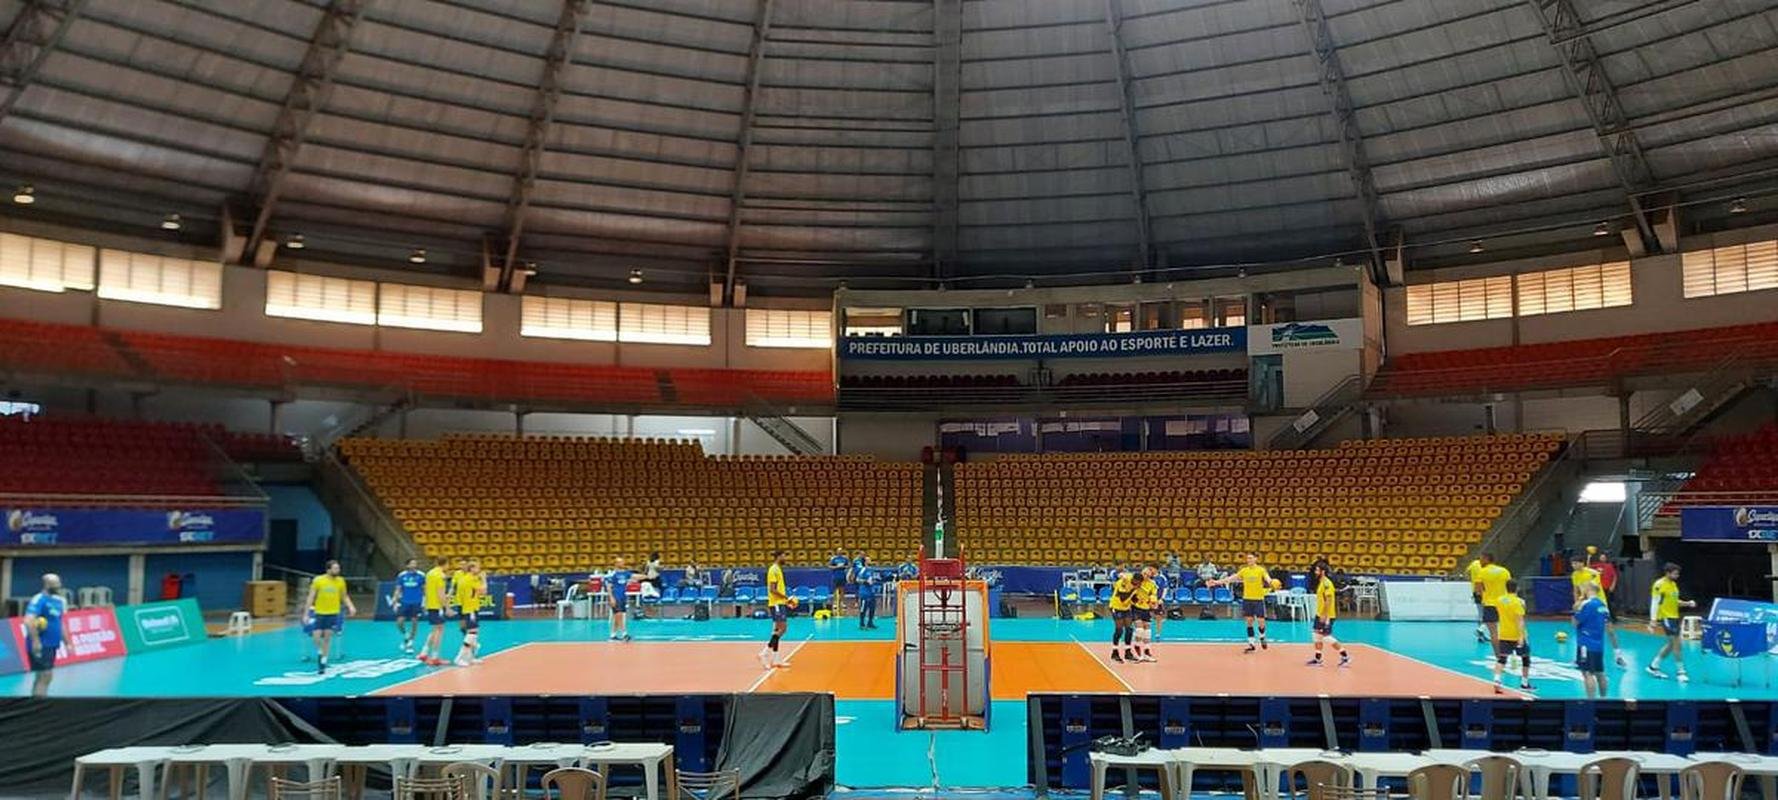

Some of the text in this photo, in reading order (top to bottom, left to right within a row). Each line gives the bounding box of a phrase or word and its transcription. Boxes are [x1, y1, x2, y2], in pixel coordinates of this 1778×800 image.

[849, 342, 922, 355] PREFEITURA
[924, 342, 940, 355] DE
[1060, 340, 1097, 353] APOIO
[1100, 339, 1117, 352] AO
[1180, 336, 1188, 348] E
